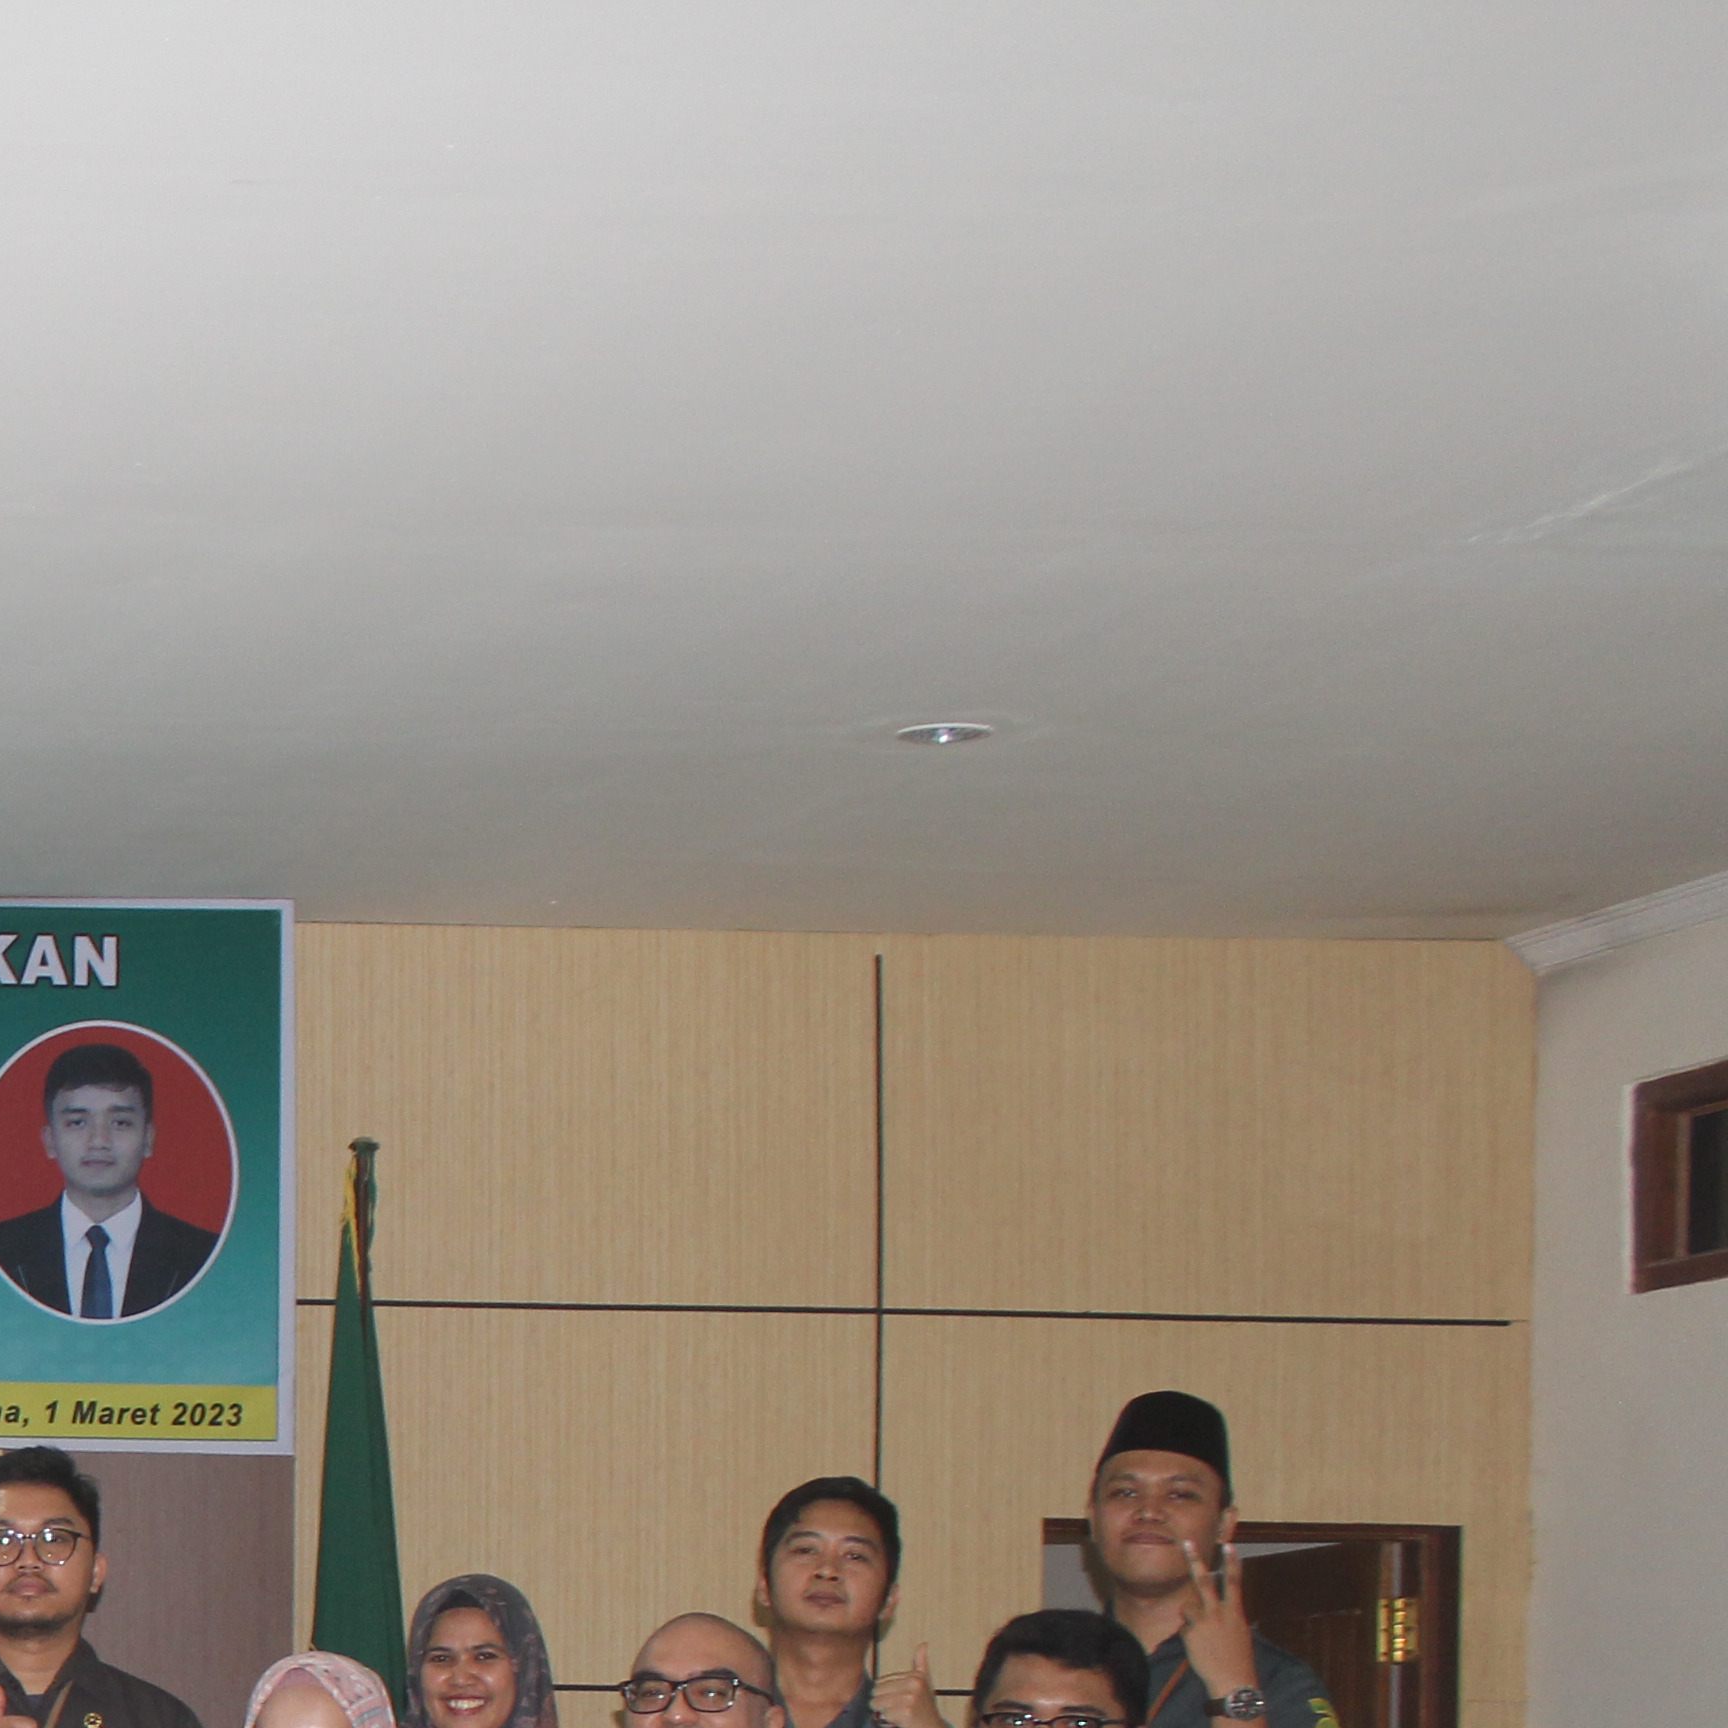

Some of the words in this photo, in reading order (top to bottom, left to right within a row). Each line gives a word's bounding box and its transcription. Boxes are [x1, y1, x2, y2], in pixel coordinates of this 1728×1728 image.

[44, 1400, 57, 1425] 1
[71, 1401, 159, 1427] Maret
[172, 1402, 244, 1428] 2023
